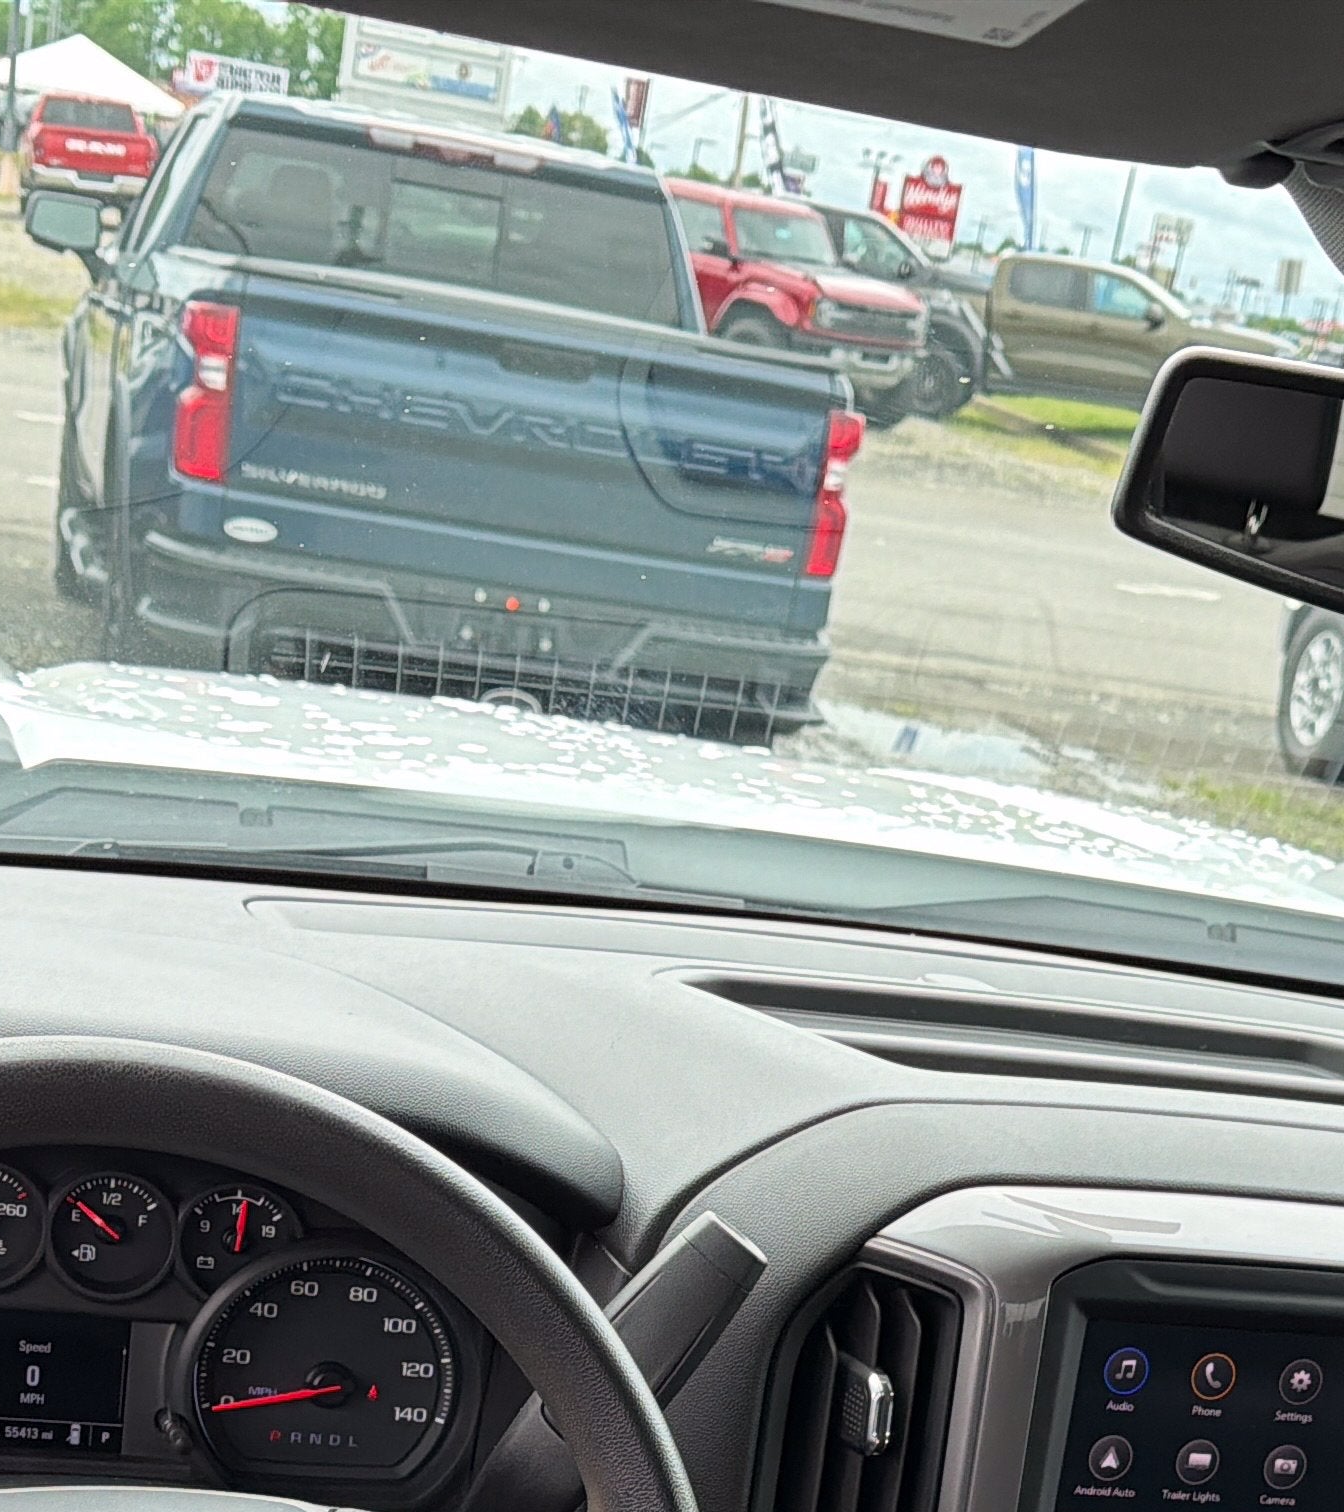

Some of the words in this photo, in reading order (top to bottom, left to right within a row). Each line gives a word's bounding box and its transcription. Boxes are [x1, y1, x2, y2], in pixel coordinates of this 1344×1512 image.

[102, 1191, 122, 1206] 1/2
[71, 1209, 81, 1223] E
[138, 1213, 148, 1228] F
[199, 1219, 210, 1233] 9
[261, 1224, 276, 1238] 19
[290, 1280, 319, 1297] 60
[349, 1286, 377, 1303] 80
[249, 1302, 278, 1319] 40
[383, 1317, 416, 1334] 100
[19, 1339, 52, 1354] Speed
[222, 1349, 251, 1365] 20
[26, 1365, 40, 1387] 0
[401, 1362, 434, 1378] 120
[19, 1392, 45, 1405] MPH
[1106, 1400, 1134, 1413] Audio
[1191, 1405, 1222, 1418] Phone
[393, 1406, 427, 1423] 140
[1274, 1411, 1313, 1424] Settings
[5, 1426, 39, 1438] 55413
[41, 1430, 53, 1440] mi
[269, 1430, 281, 1442] P
[290, 1432, 301, 1444] R
[309, 1433, 322, 1445] N
[329, 1434, 341, 1447] D
[1073, 1485, 1109, 1498] Android
[1110, 1487, 1136, 1499] Auto
[1162, 1489, 1190, 1502] Trailer
[1192, 1491, 1221, 1504] Lights
[1259, 1494, 1296, 1507] Camera
